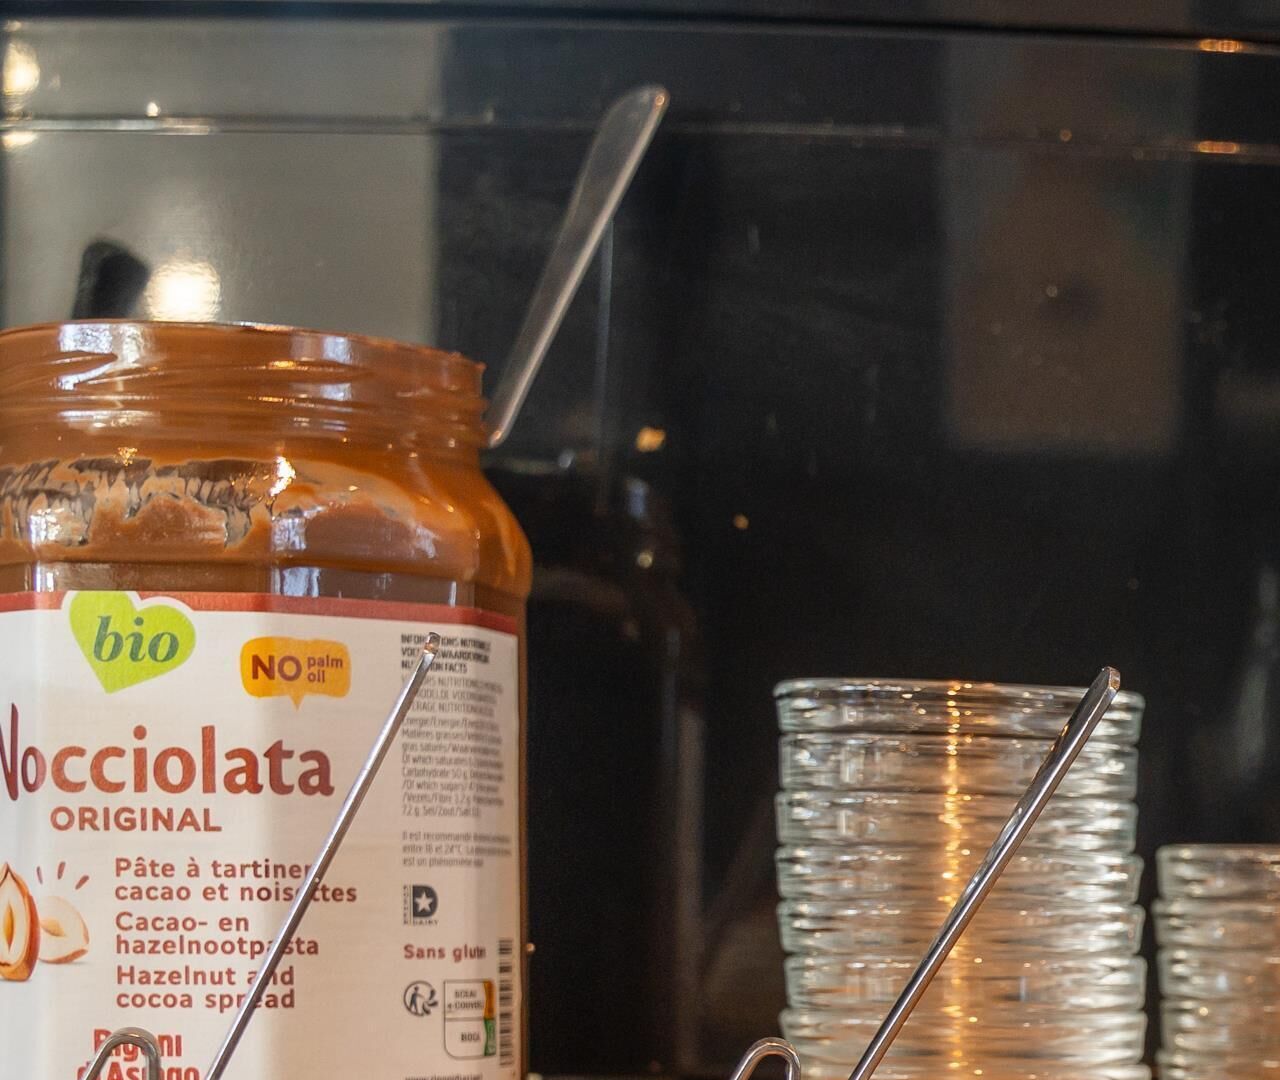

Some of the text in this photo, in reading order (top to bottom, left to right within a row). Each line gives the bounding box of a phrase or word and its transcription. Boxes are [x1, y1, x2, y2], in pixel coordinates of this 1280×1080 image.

[92, 614, 180, 663] bio
[251, 654, 303, 682] NO
[306, 654, 344, 670] palm
[306, 671, 326, 683] oil
[50, 806, 222, 832] ORIGINAL
[115, 856, 175, 878] Pâte
[187, 857, 200, 878] à
[115, 884, 191, 902] cacao
[202, 883, 229, 902] et
[115, 911, 249, 932] Cacao- en
[403, 943, 446, 960] Sans
[116, 965, 236, 986] Hazelnut
[116, 989, 295, 1014] cocoa sprad
